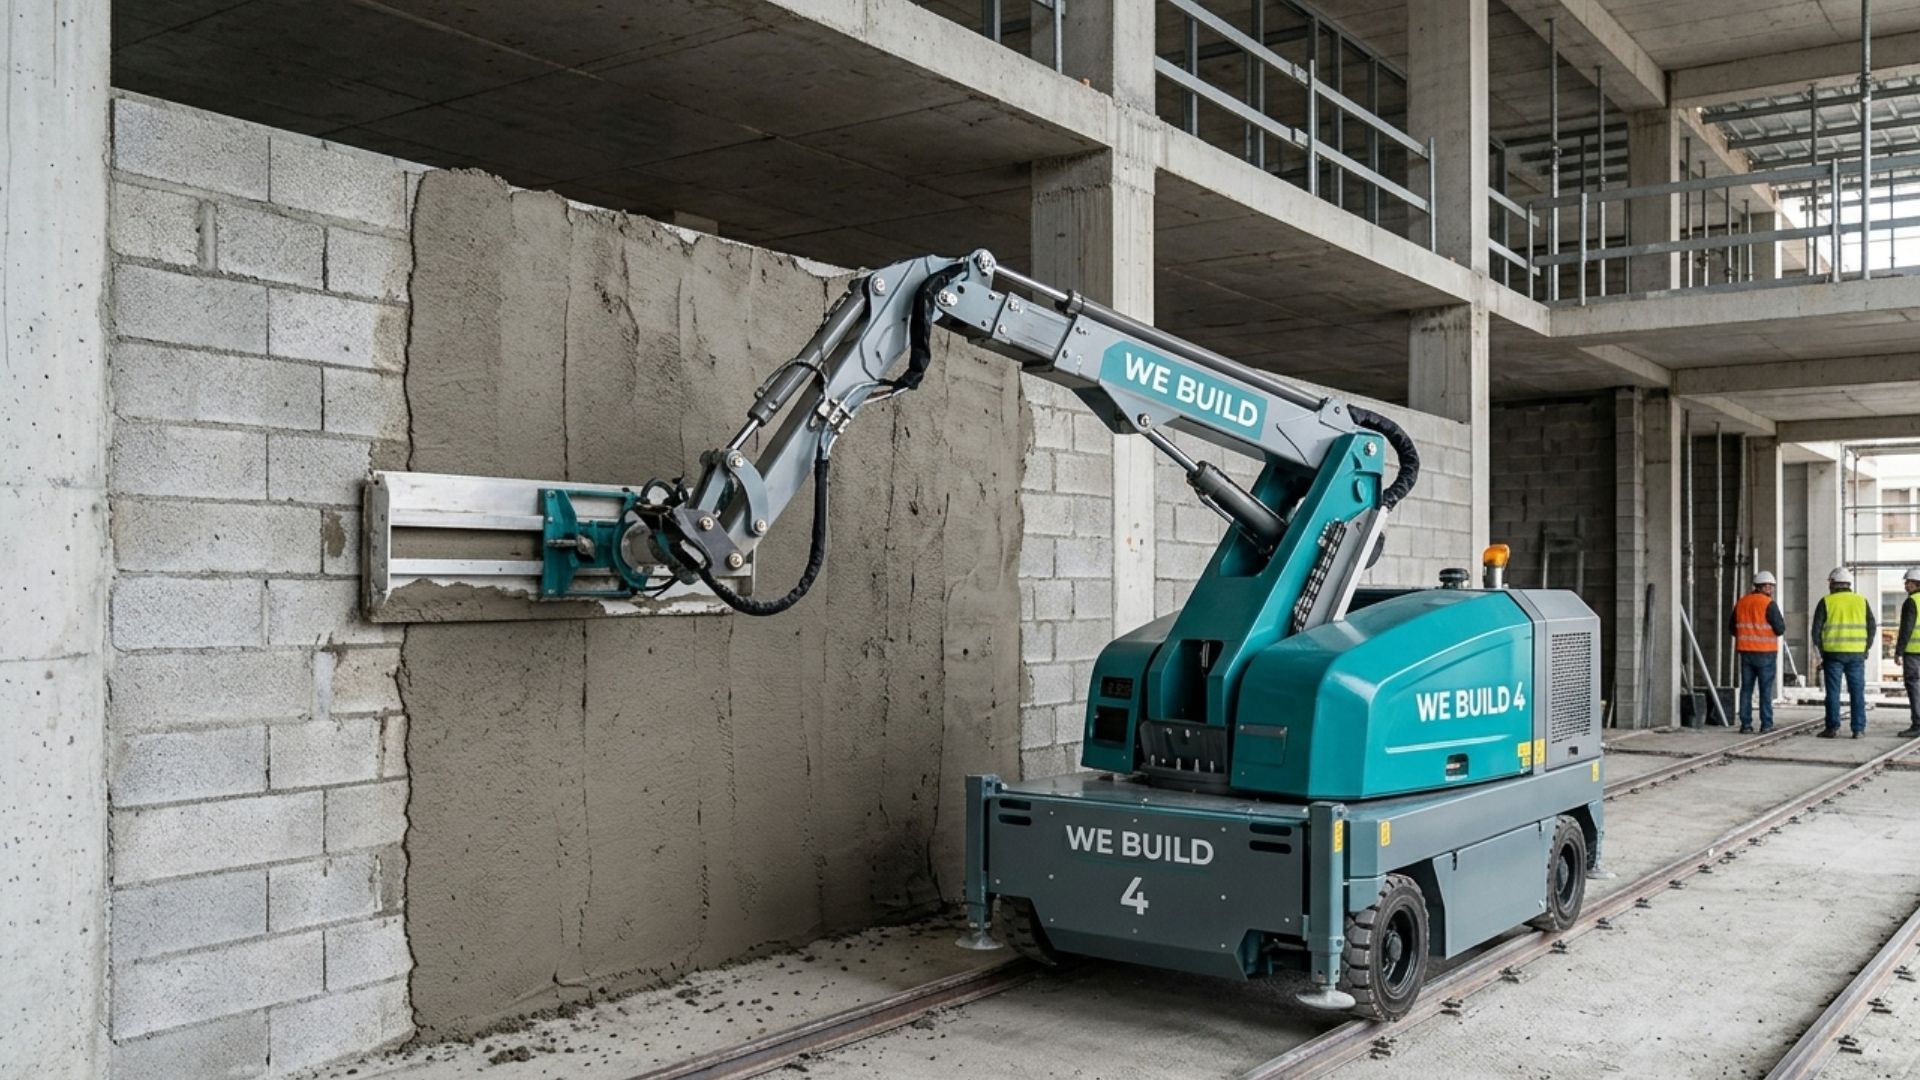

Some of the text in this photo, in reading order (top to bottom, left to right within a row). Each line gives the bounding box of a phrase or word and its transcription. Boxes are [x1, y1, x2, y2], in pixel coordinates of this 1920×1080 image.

[1126, 352, 1258, 427] WE BUILD
[1416, 681, 1526, 722] WE BUILD 4
[1066, 825, 1214, 865] WE BUILD
[1120, 876, 1149, 915] 4
